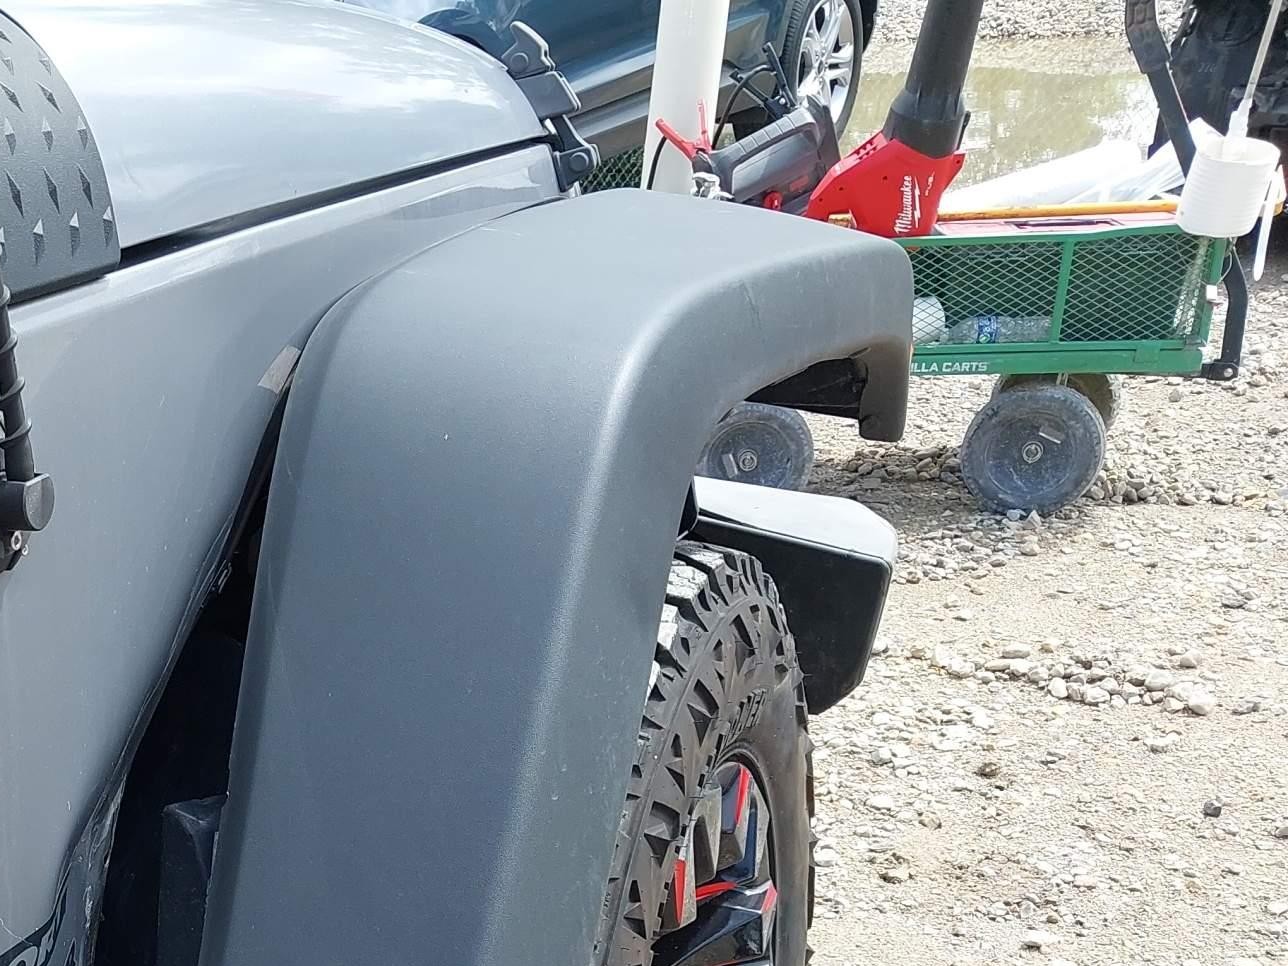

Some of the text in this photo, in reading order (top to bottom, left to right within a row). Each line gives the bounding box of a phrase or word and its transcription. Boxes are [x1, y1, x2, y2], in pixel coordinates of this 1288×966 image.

[893, 175, 913, 235] Milwaukee
[910, 361, 989, 373] ILLA CARTS
